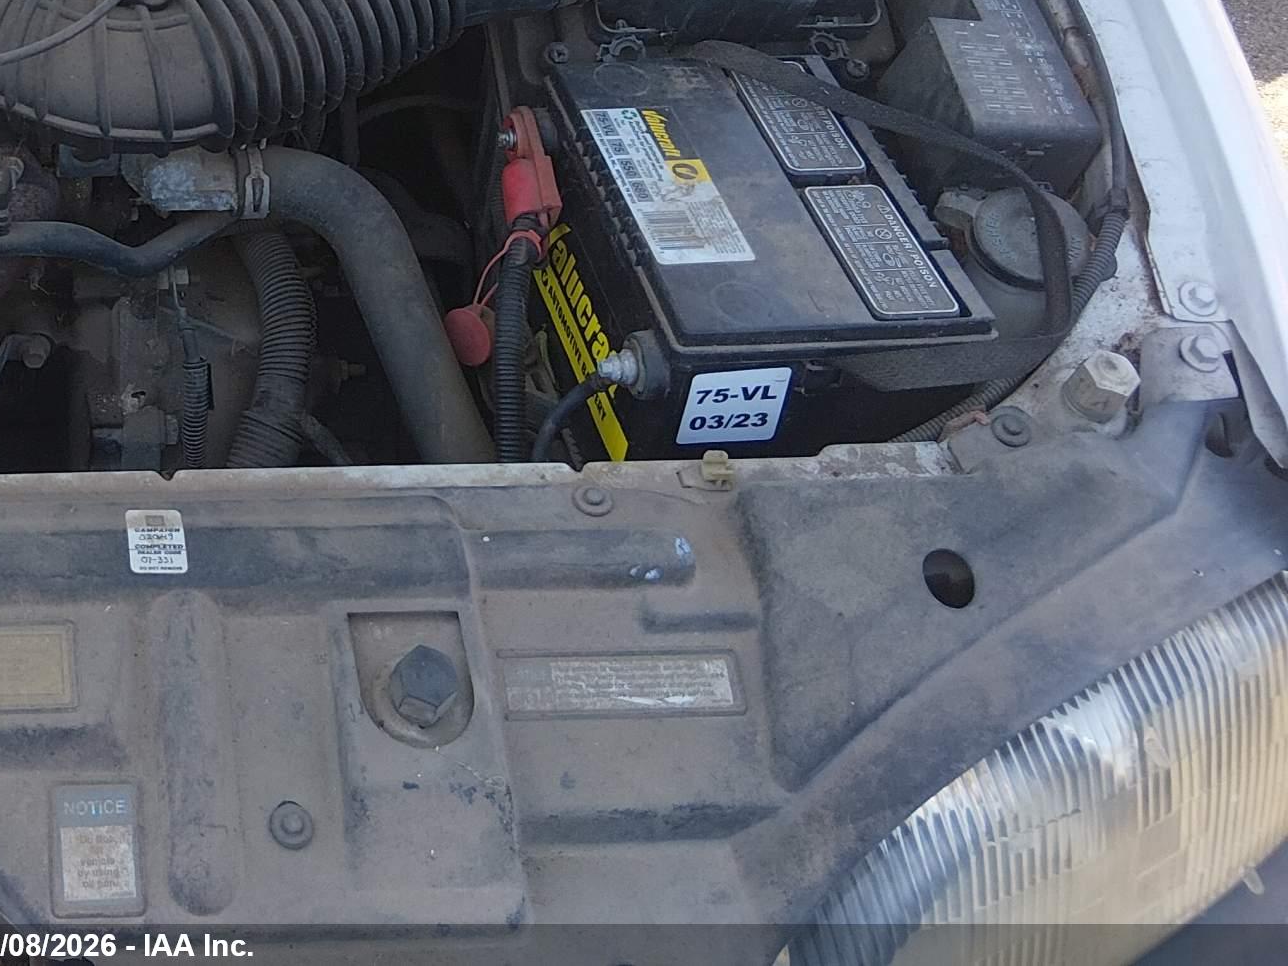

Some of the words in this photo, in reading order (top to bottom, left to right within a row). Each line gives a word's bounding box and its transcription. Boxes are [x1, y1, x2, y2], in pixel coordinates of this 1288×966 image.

[596, 113, 614, 135] 75-VL
[642, 111, 681, 157] Valucraft
[613, 142, 622, 152] 75
[620, 160, 636, 176] 550
[632, 182, 648, 199] 680
[548, 286, 585, 364] AUTOMOTIVE
[696, 385, 777, 405] 75-VL
[689, 412, 769, 430] 03/23
[63, 800, 127, 815] NOTICE
